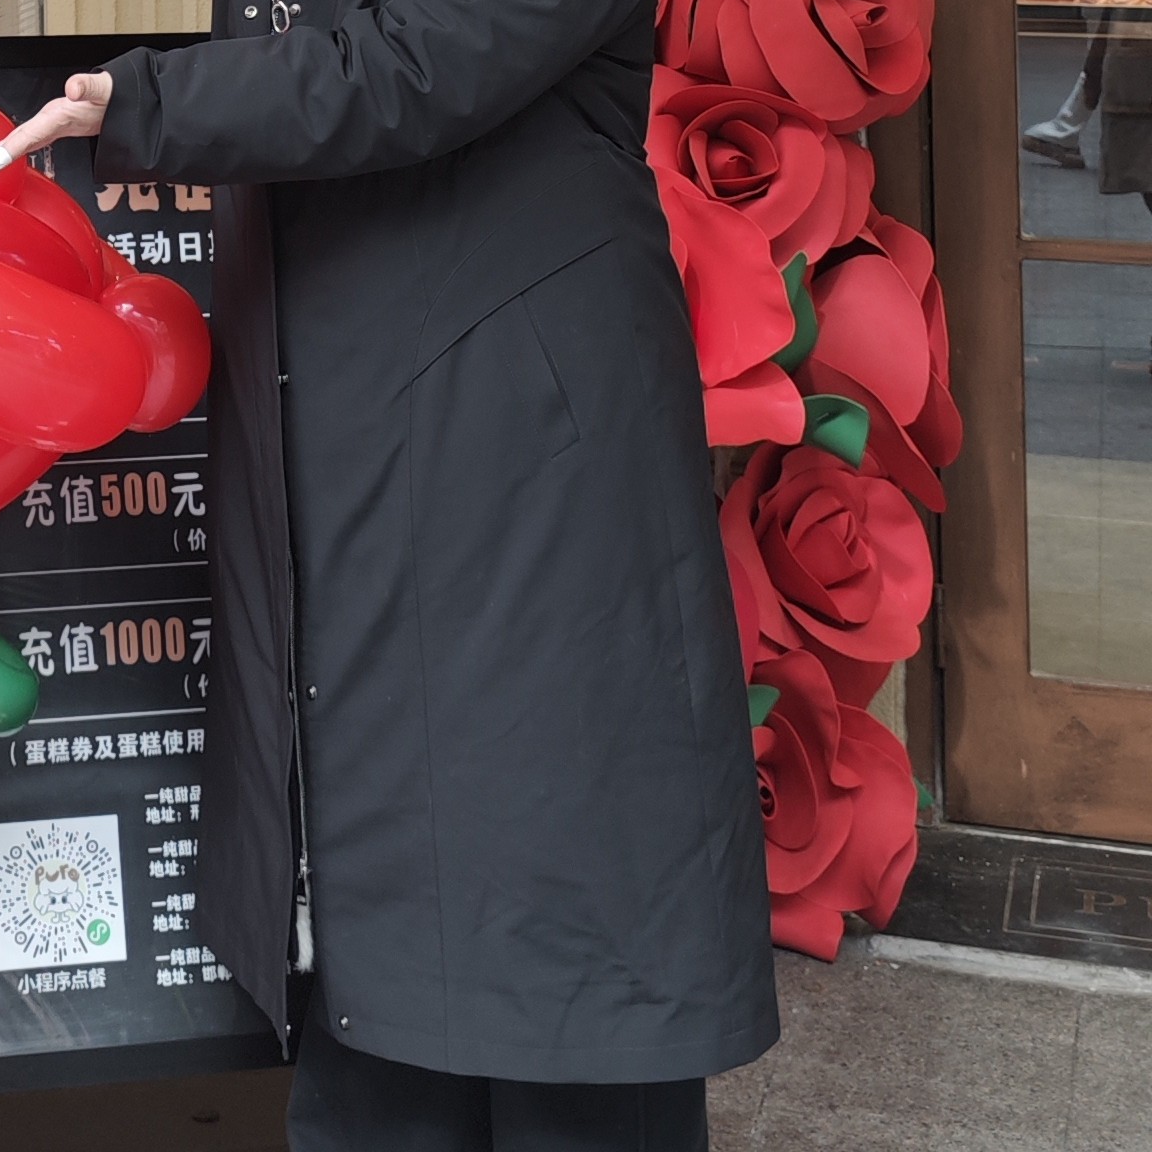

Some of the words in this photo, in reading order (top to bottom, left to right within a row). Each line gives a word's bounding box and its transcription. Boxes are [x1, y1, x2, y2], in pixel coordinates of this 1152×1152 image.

[107, 229, 214, 265] 活动日
[22, 471, 206, 528] 充值500元
[18, 617, 212, 676] 充值1000元
[148, 838, 198, 858] 一纯甜
[17, 968, 107, 995] 小程序点餐
